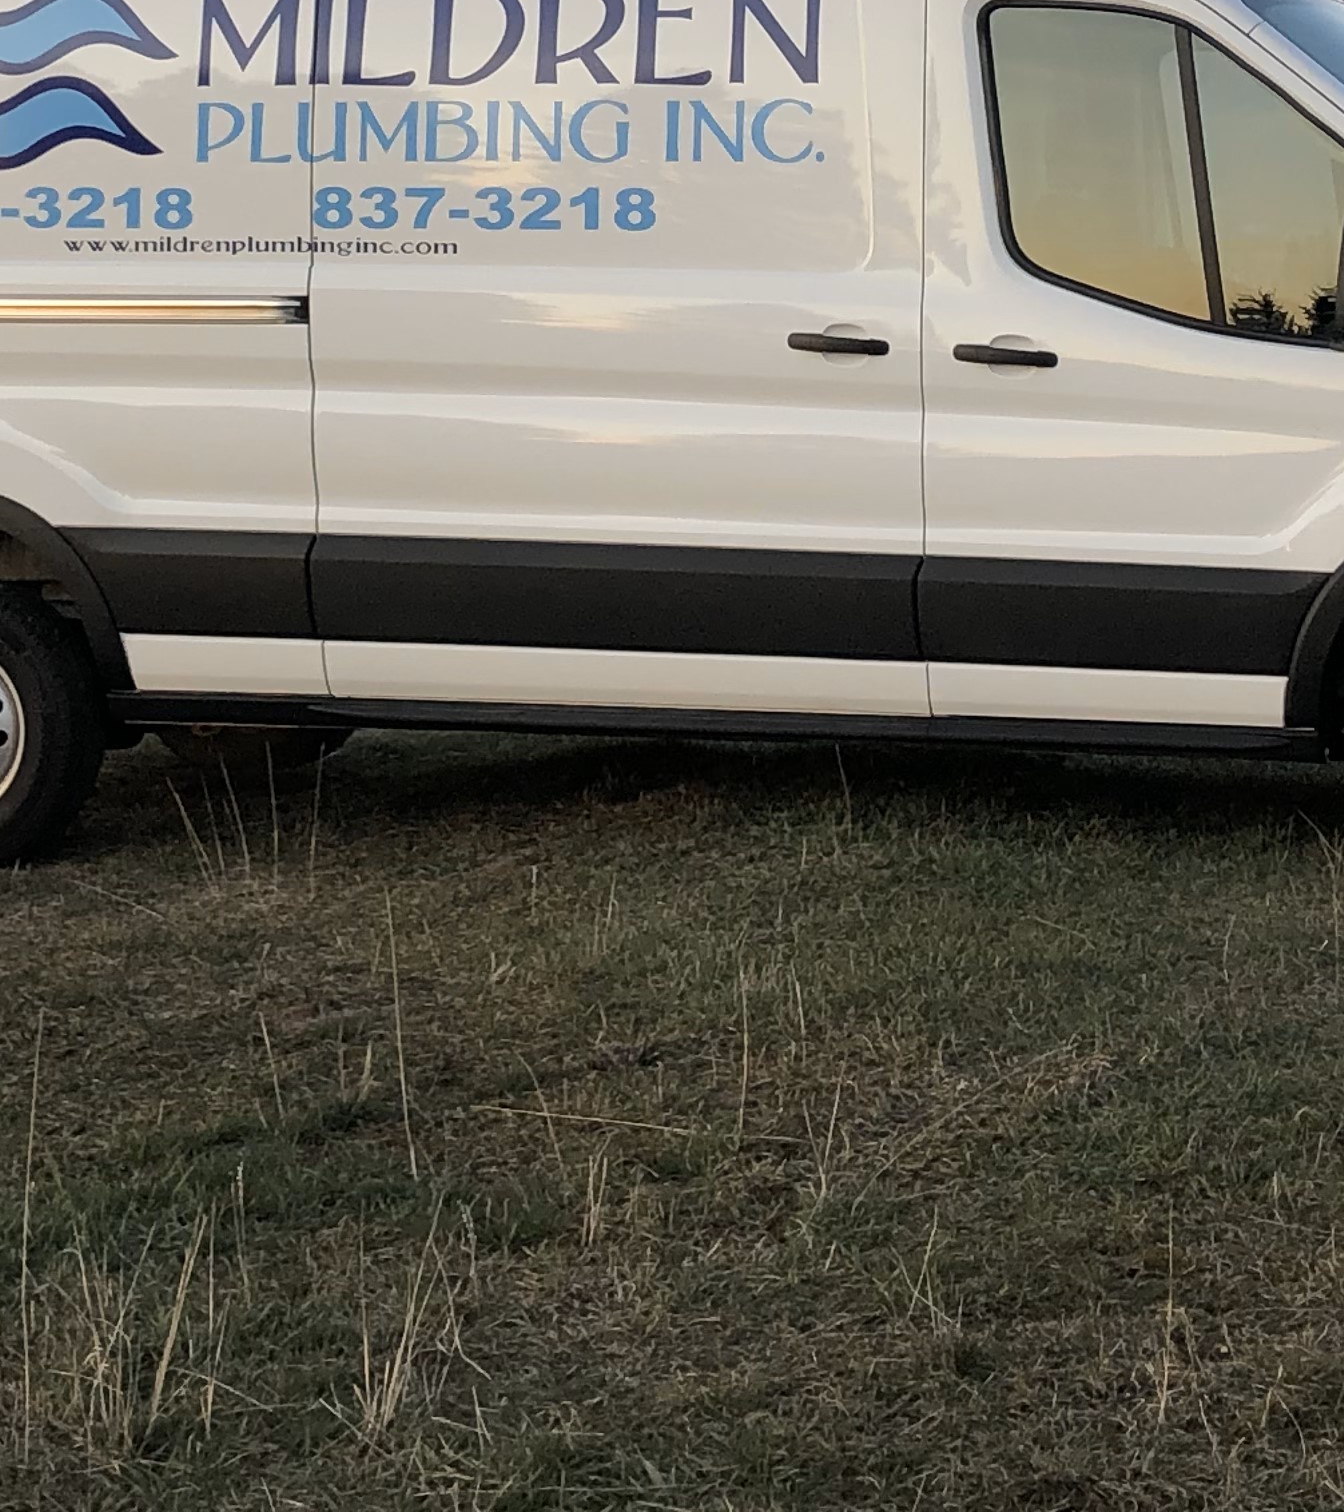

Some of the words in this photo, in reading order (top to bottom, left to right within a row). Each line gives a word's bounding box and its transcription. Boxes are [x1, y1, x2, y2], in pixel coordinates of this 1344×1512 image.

[196, 98, 630, 164] PLUMBING
[664, 98, 825, 164] INC.
[312, 186, 656, 231] 837-3218
[63, 235, 458, 256] www.mildrenplumbinginc.com
